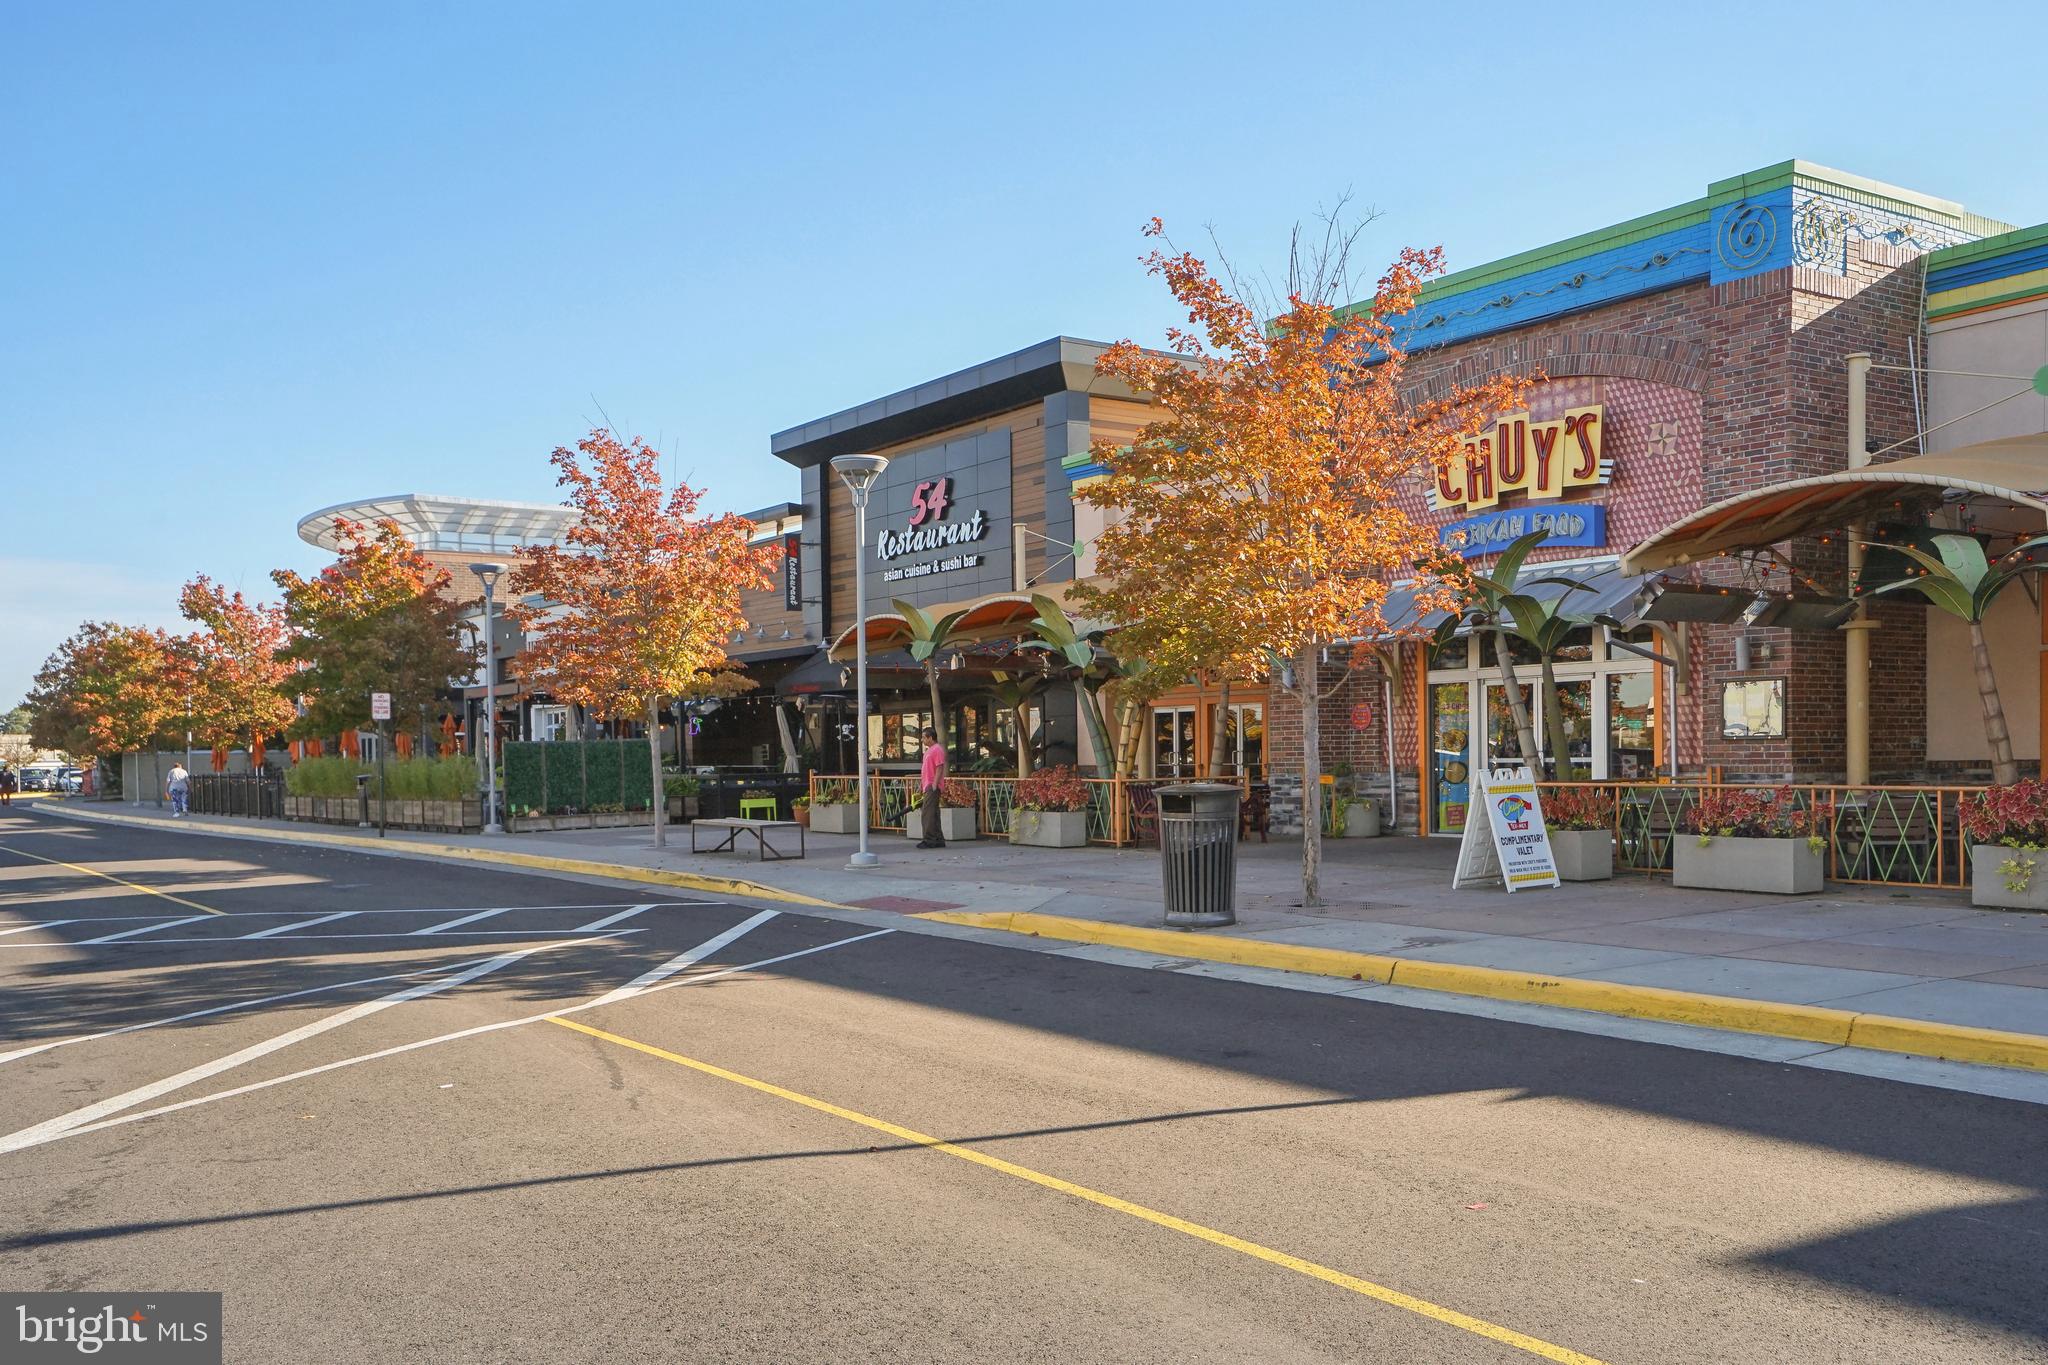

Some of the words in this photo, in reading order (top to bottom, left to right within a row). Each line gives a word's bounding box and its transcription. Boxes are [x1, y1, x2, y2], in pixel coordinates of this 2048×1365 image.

[1438, 412, 1598, 502] CHUY'S
[909, 477, 948, 526] 54
[877, 509, 983, 561] Restaurant
[1532, 512, 1586, 538] FOOD
[788, 557, 798, 606] Restaurant
[884, 567, 903, 582] asian
[904, 562, 931, 579] cuisine
[932, 559, 939, 573] &
[941, 555, 962, 571] sushi
[963, 554, 978, 568] bar
[1500, 833, 1544, 846] COMPLIMENTARY
[1516, 846, 1534, 856] VALET
